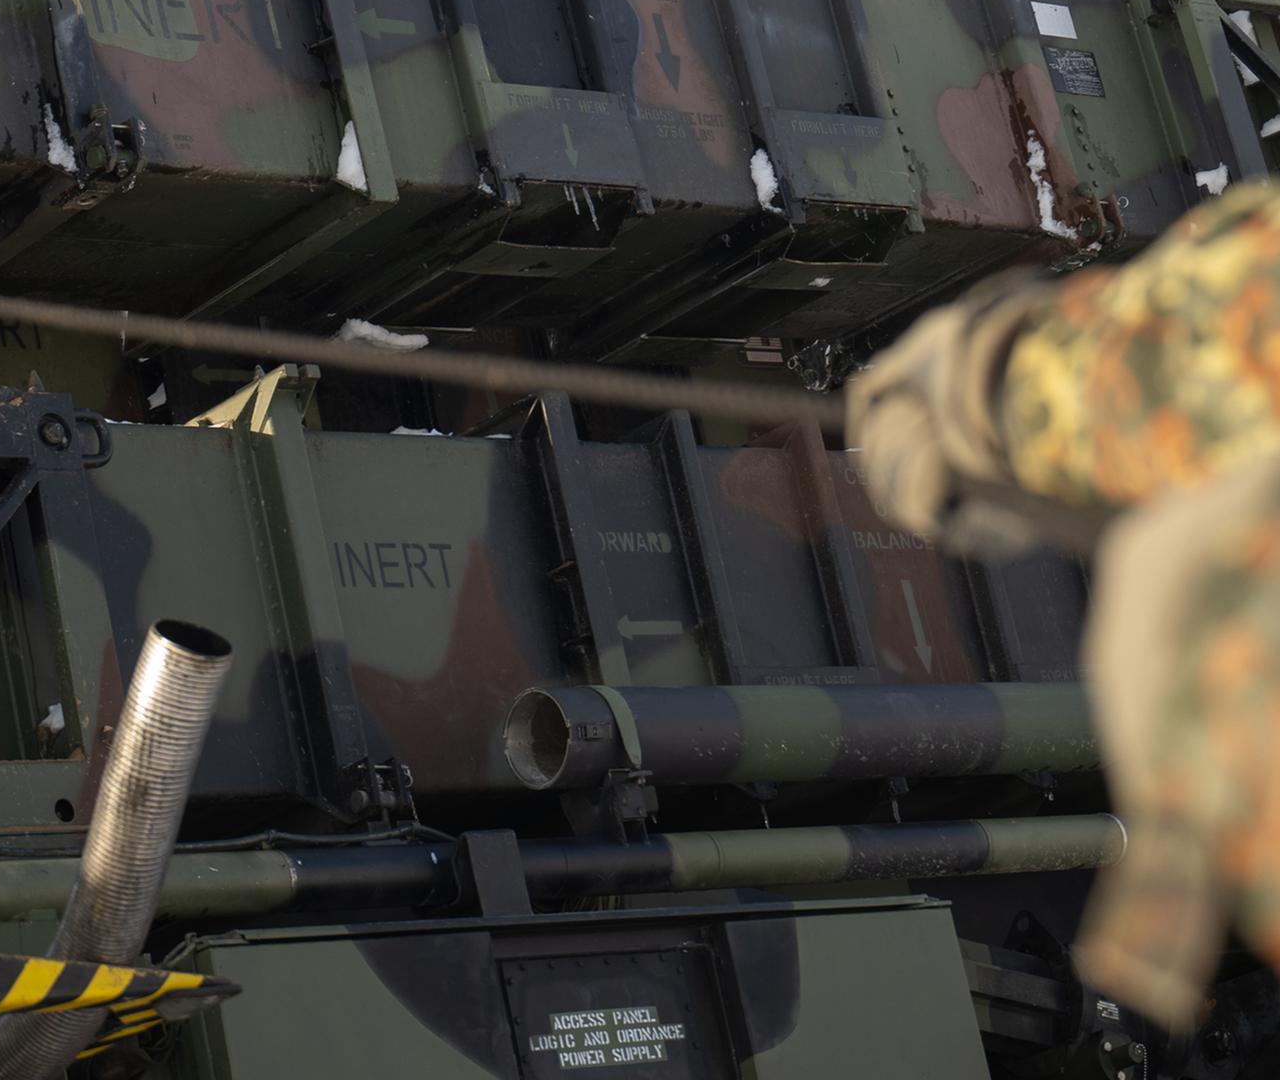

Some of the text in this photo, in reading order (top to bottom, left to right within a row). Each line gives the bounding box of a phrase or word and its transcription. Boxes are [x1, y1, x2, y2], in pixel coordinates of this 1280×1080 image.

[578, 97, 610, 116] HERE
[791, 119, 881, 138] FORKLIFT HERE
[851, 530, 936, 551] BALANCE
[333, 542, 452, 588] INERT
[553, 1008, 657, 1031] ACCESS PANEL
[528, 1023, 686, 1052] LOGIC AND ORDNANCE
[559, 1044, 663, 1068] POWER SUPPLY
